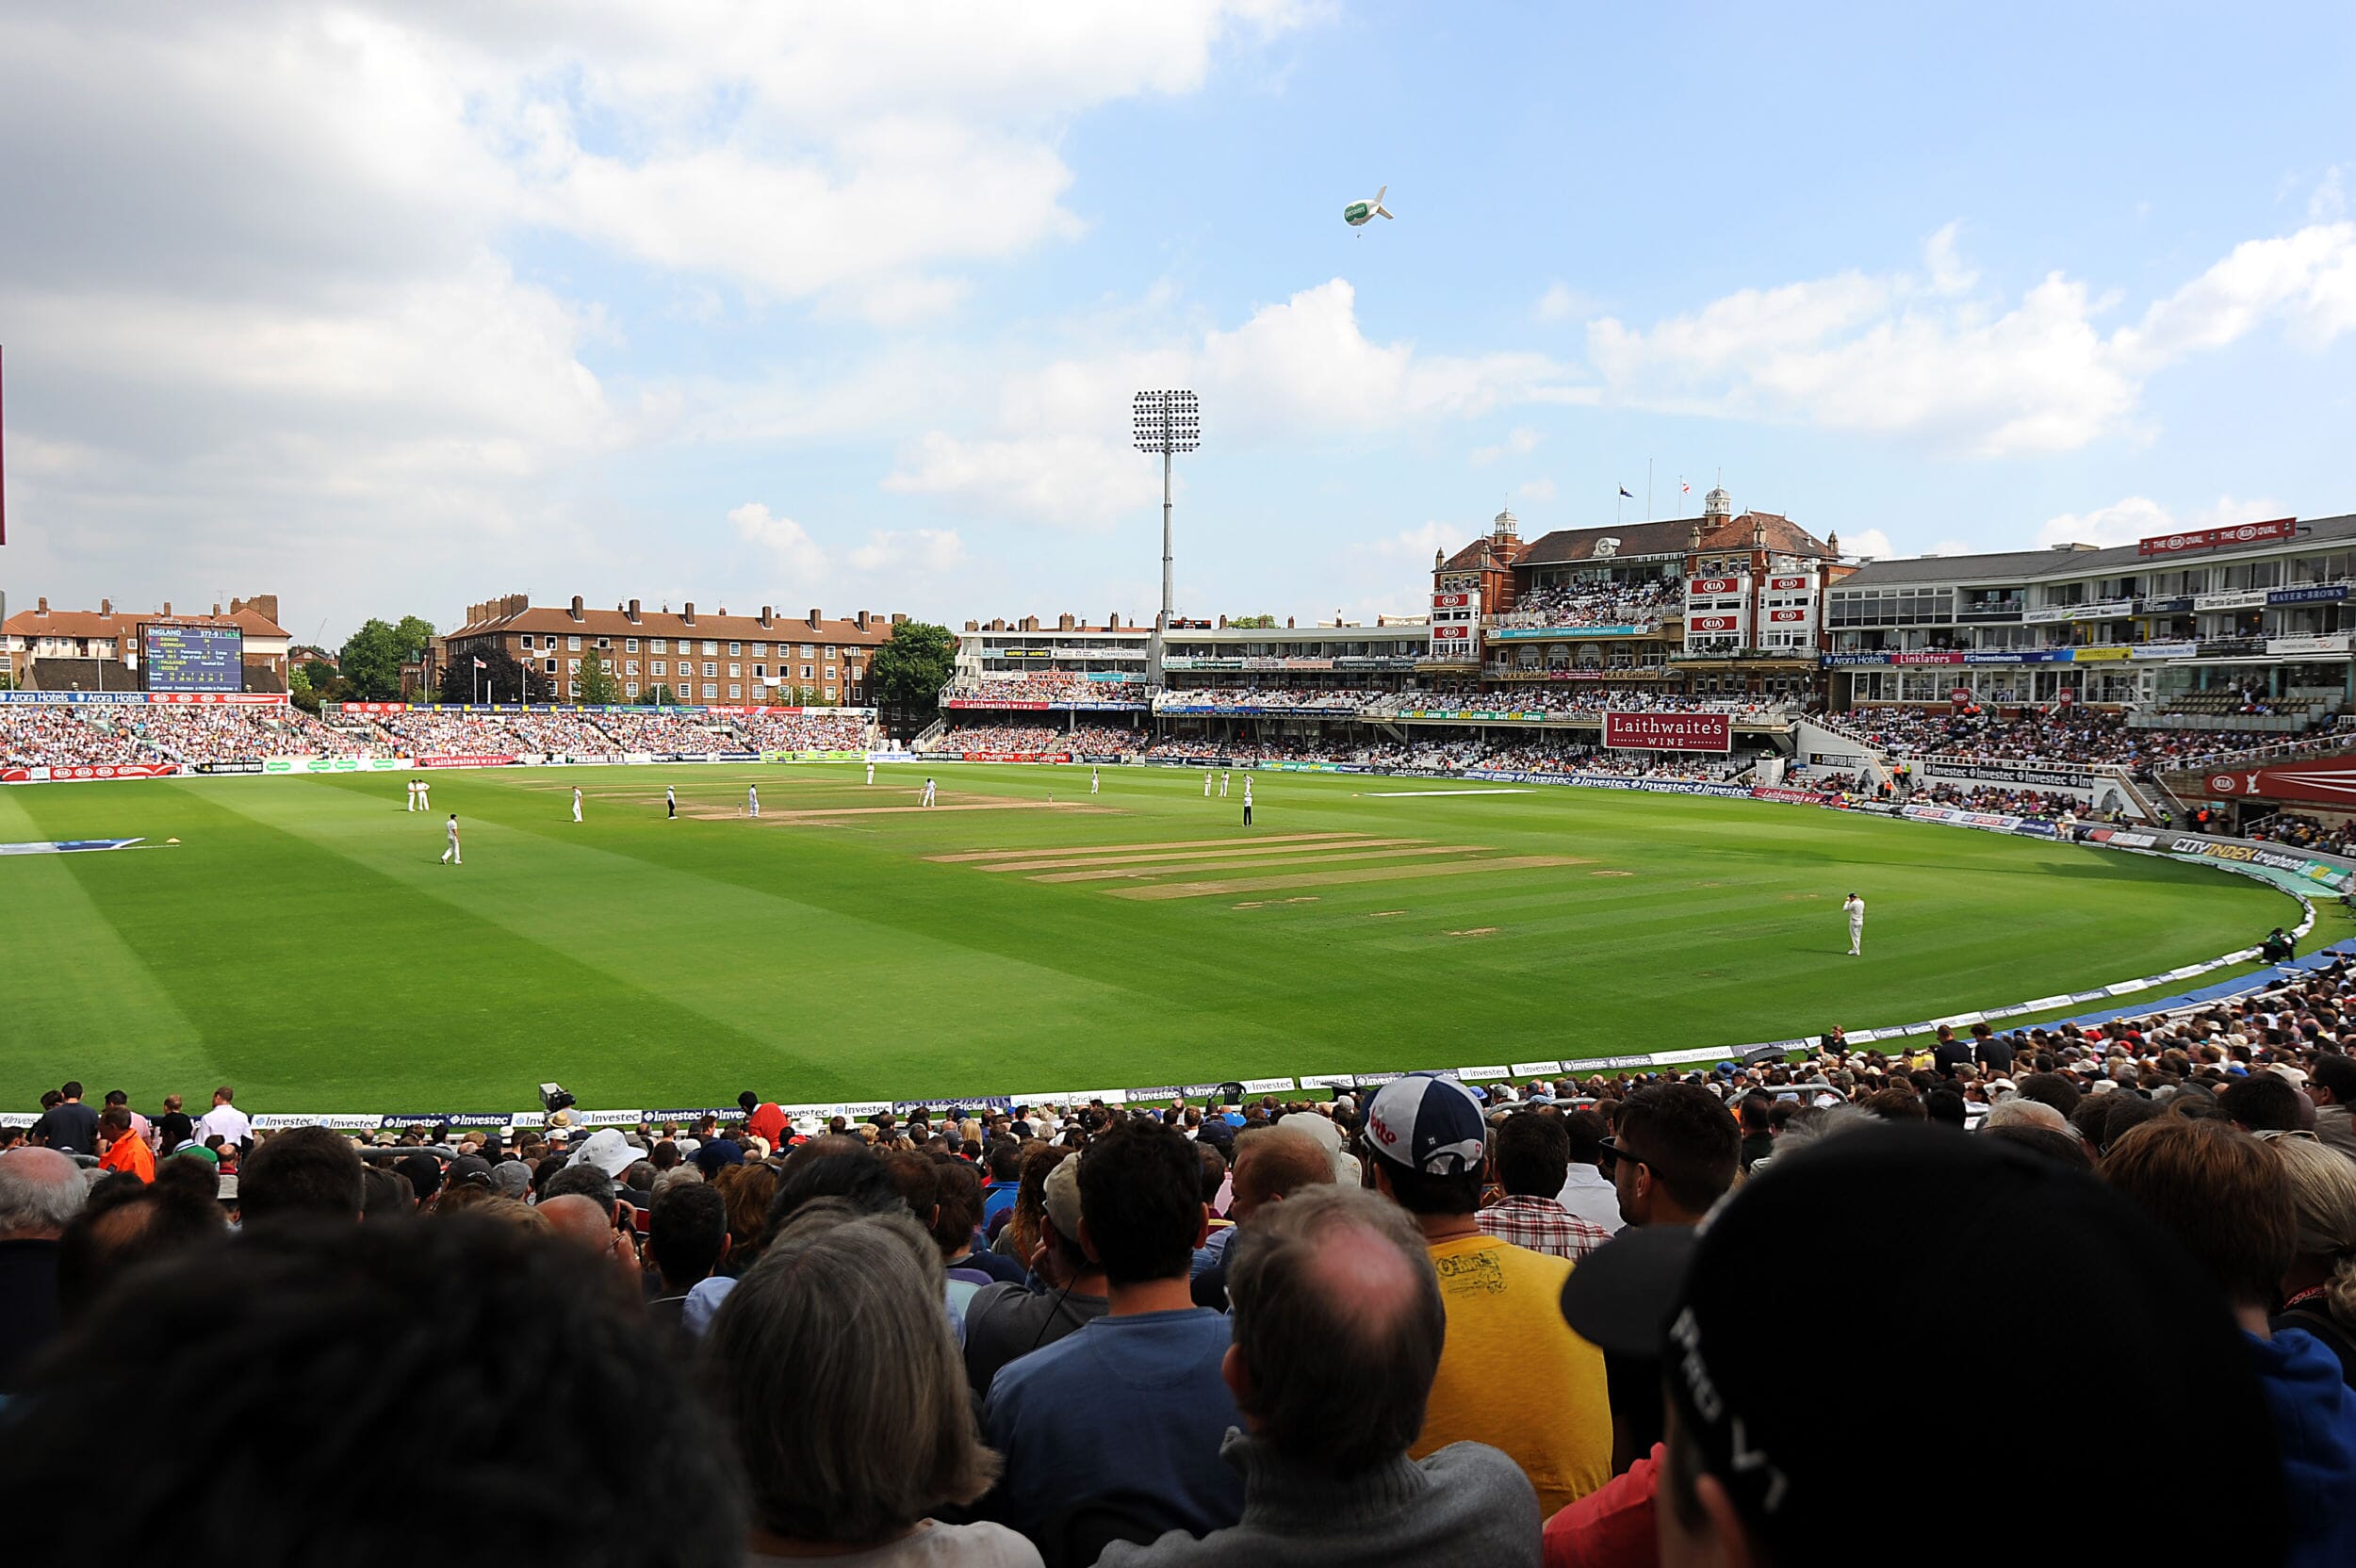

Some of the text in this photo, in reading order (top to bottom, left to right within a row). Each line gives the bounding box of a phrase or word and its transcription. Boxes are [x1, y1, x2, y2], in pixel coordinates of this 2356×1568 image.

[2220, 531, 2235, 539] THE
[2258, 526, 2277, 535] OVAL
[2185, 535, 2203, 544] OVAL
[1706, 581, 1722, 590] KIA
[1781, 580, 1795, 588] KIA
[1443, 596, 1458, 605] KIA
[1443, 629, 1458, 637] KIA
[1833, 655, 1885, 665] Arora Hotels
[1900, 653, 1950, 664] Linklaters
[1627, 671, 1657, 679] Galadari
[9, 694, 69, 703] Arora Hotels
[115, 694, 145, 703] Hotels
[964, 701, 1010, 710] Laithwaite's
[1400, 710, 1442, 720] bet365.com
[1446, 710, 1489, 720] bet365.com
[1495, 711, 1541, 722] bet365.com
[1613, 717, 1723, 735] Laithwaite's
[1647, 738, 1684, 746] WINE
[431, 758, 480, 766] Laithwaite's
[981, 754, 1014, 762] Pedigree
[1822, 755, 1847, 766] STOWFORD
[212, 764, 243, 773] STOWFORD
[244, 763, 262, 772] PRESS
[1392, 768, 1435, 776] JAGUAR
[1932, 764, 1968, 777] Investec
[1976, 767, 2014, 781] Investec
[2025, 771, 2067, 786] Investec
[1525, 774, 1571, 785] Investec
[1580, 776, 1629, 789] Investec
[2216, 778, 2231, 789] KIA
[1640, 781, 1693, 793] Investec
[1703, 784, 1752, 797] Investec
[1917, 808, 1942, 818] SPORTS
[1974, 816, 2002, 825] SPORTS
[1572, 1058, 1608, 1070] Investec
[1616, 1056, 1651, 1067] Investec
[1470, 1068, 1507, 1078] Investec
[1523, 1063, 1559, 1073] Investec
[1252, 1080, 1292, 1090] Investec
[1138, 1089, 1180, 1102] Investec
[844, 1103, 890, 1115] Investec
[461, 1115, 509, 1126] Investec
[591, 1113, 640, 1123] Investec
[654, 1110, 702, 1121] Investec
[265, 1117, 315, 1128] Investec
[331, 1118, 379, 1129] Investec
[394, 1117, 445, 1129] Investec
